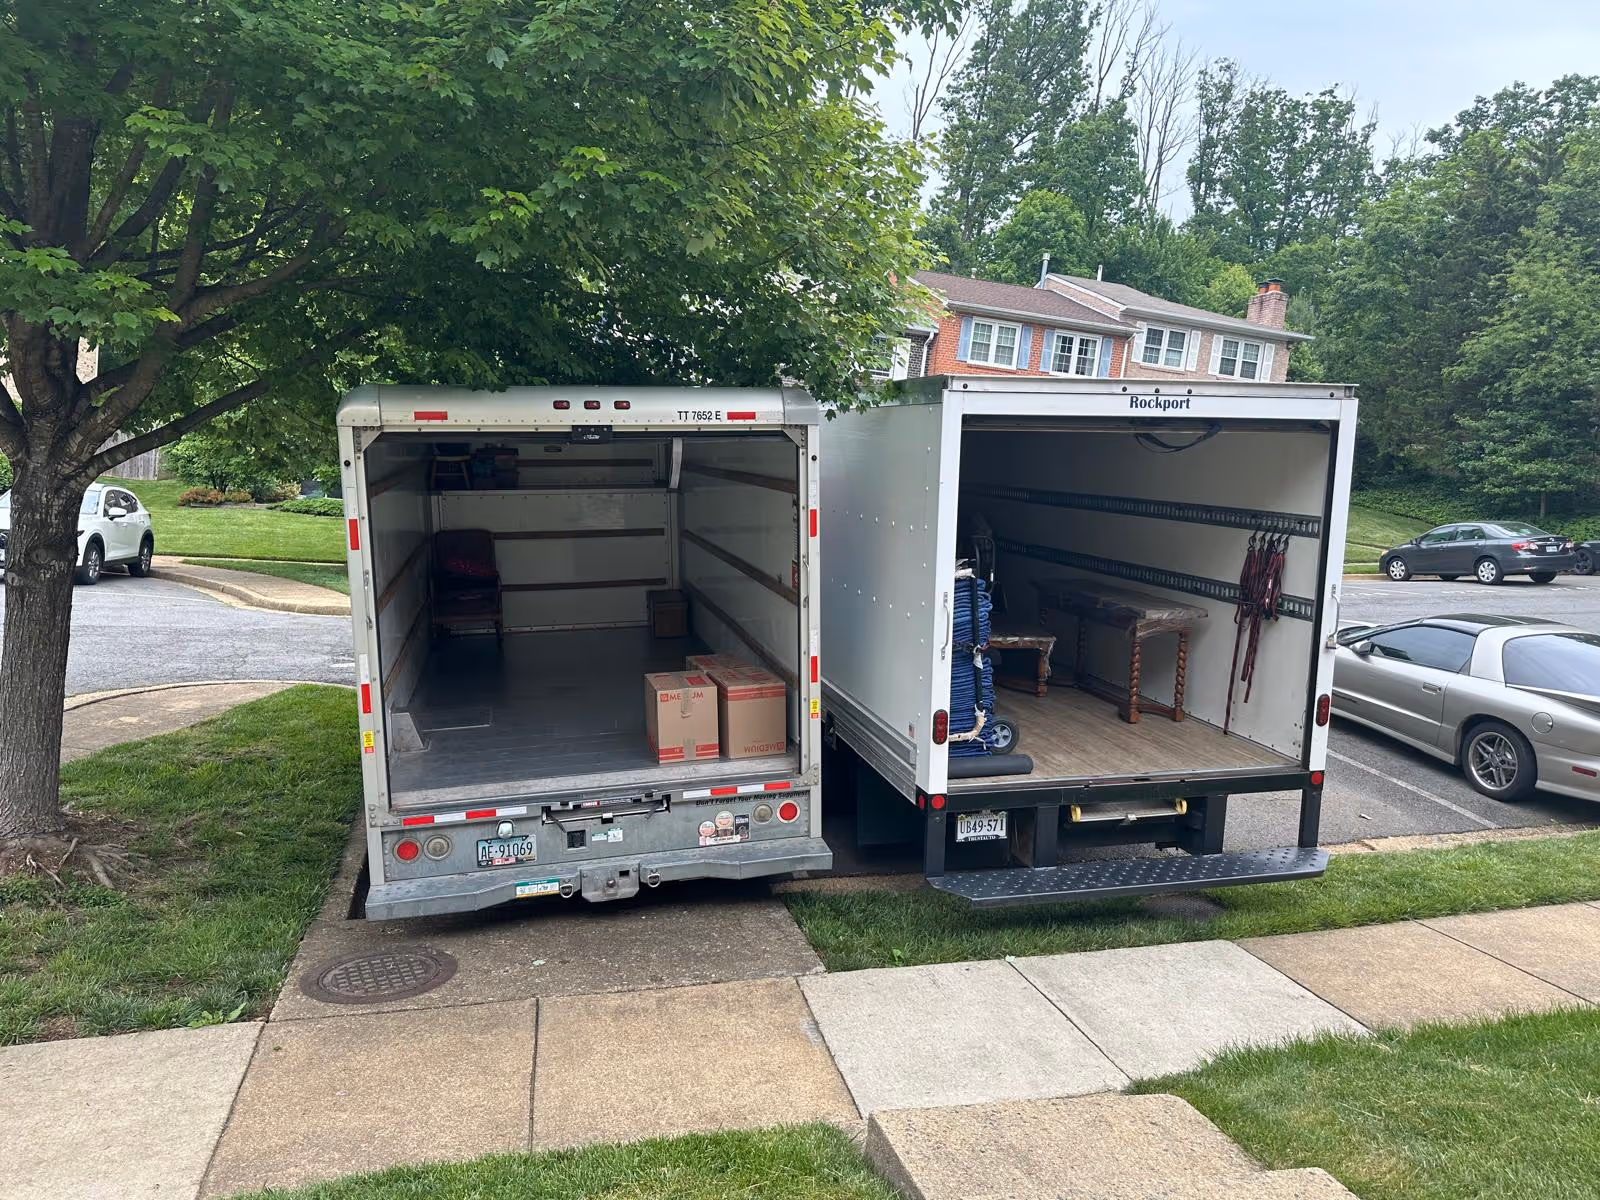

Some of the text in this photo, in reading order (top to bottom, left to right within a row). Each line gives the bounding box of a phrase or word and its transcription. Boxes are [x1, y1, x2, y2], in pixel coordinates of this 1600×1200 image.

[1129, 395, 1191, 412] Rockport
[677, 410, 721, 421] TT 7652 E
[669, 691, 704, 701] MEUM
[743, 743, 777, 753] MEDIUM
[696, 798, 714, 806] Don't
[715, 796, 737, 805] Forget
[754, 793, 777, 801] Moving
